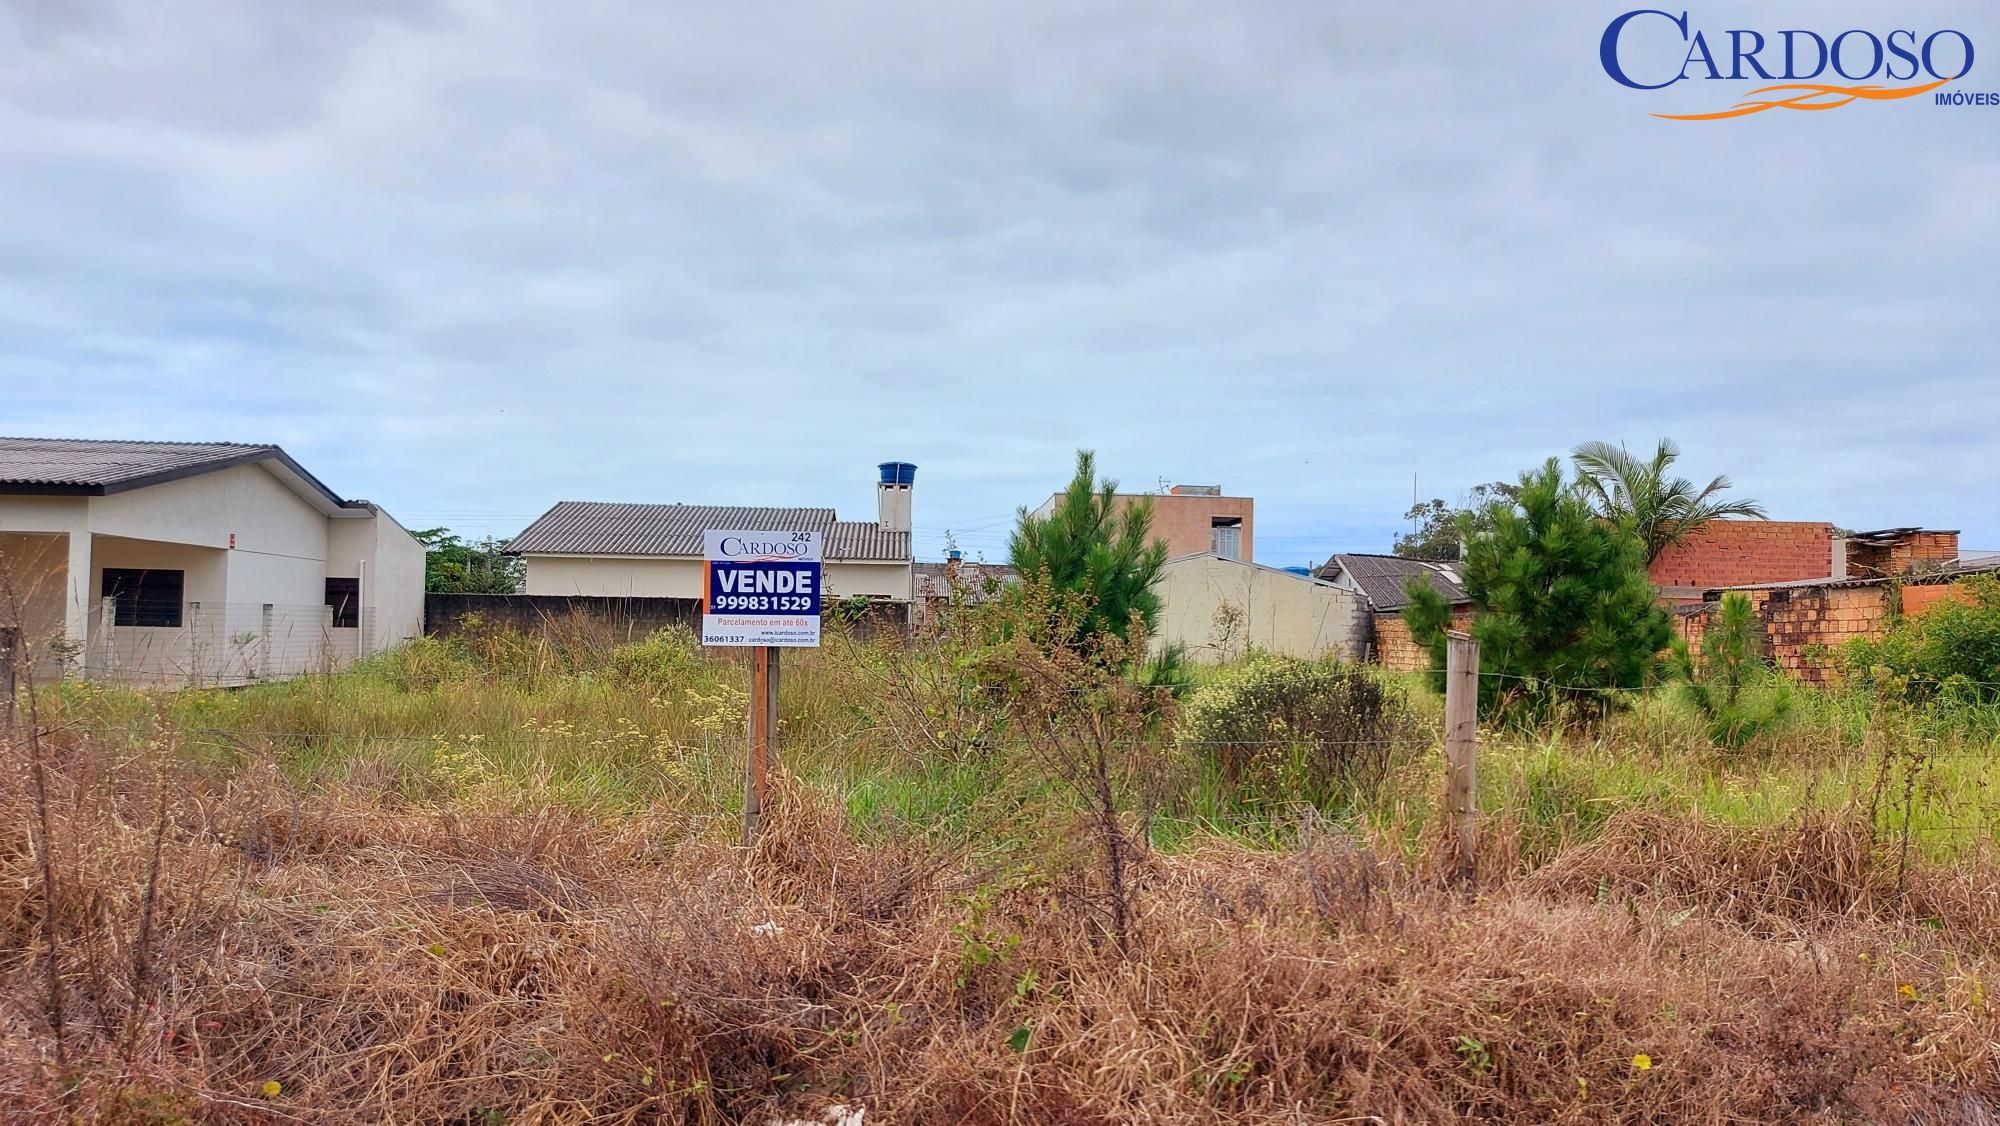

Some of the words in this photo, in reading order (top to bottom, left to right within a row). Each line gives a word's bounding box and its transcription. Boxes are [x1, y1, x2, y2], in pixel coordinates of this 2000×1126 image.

[791, 532, 811, 542] 242
[720, 537, 808, 556] CARDOSO
[717, 570, 812, 593] VENDE
[716, 595, 812, 611] 999831529
[717, 618, 768, 627] Parcelamento
[770, 619, 781, 627] em
[782, 618, 794, 627] até
[795, 618, 808, 627] 60x
[704, 635, 745, 643] 36061337
